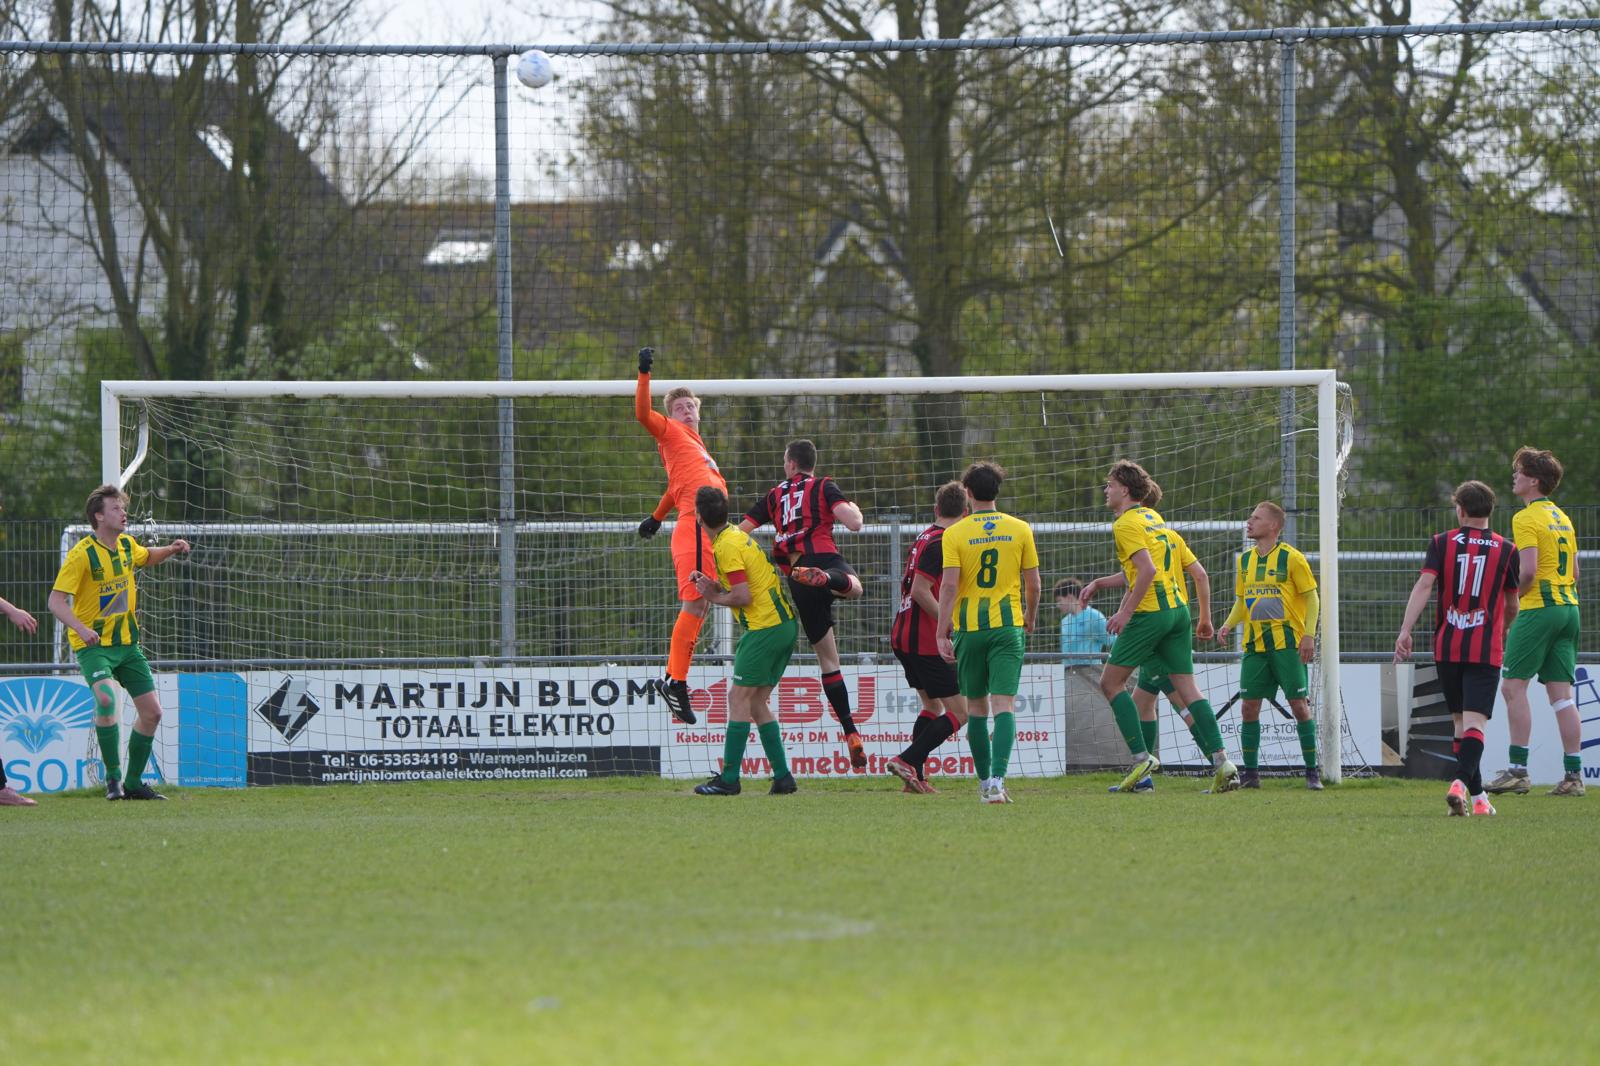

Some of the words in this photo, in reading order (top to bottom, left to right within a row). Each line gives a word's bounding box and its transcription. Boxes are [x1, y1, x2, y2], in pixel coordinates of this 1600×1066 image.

[780, 490, 804, 527] 12
[1468, 537, 1500, 548] KOKS
[976, 547, 999, 589] 8
[1457, 553, 1487, 597] 11
[334, 681, 520, 710] MARTIJN
[538, 678, 656, 707] BLOM
[672, 676, 876, 724] MBU
[375, 714, 481, 739] TOTAAL
[489, 712, 615, 737] ELEKTRO
[808, 732, 829, 743] DM
[359, 752, 458, 767] 06-53634119
[469, 750, 588, 765] Warmenhuizen
